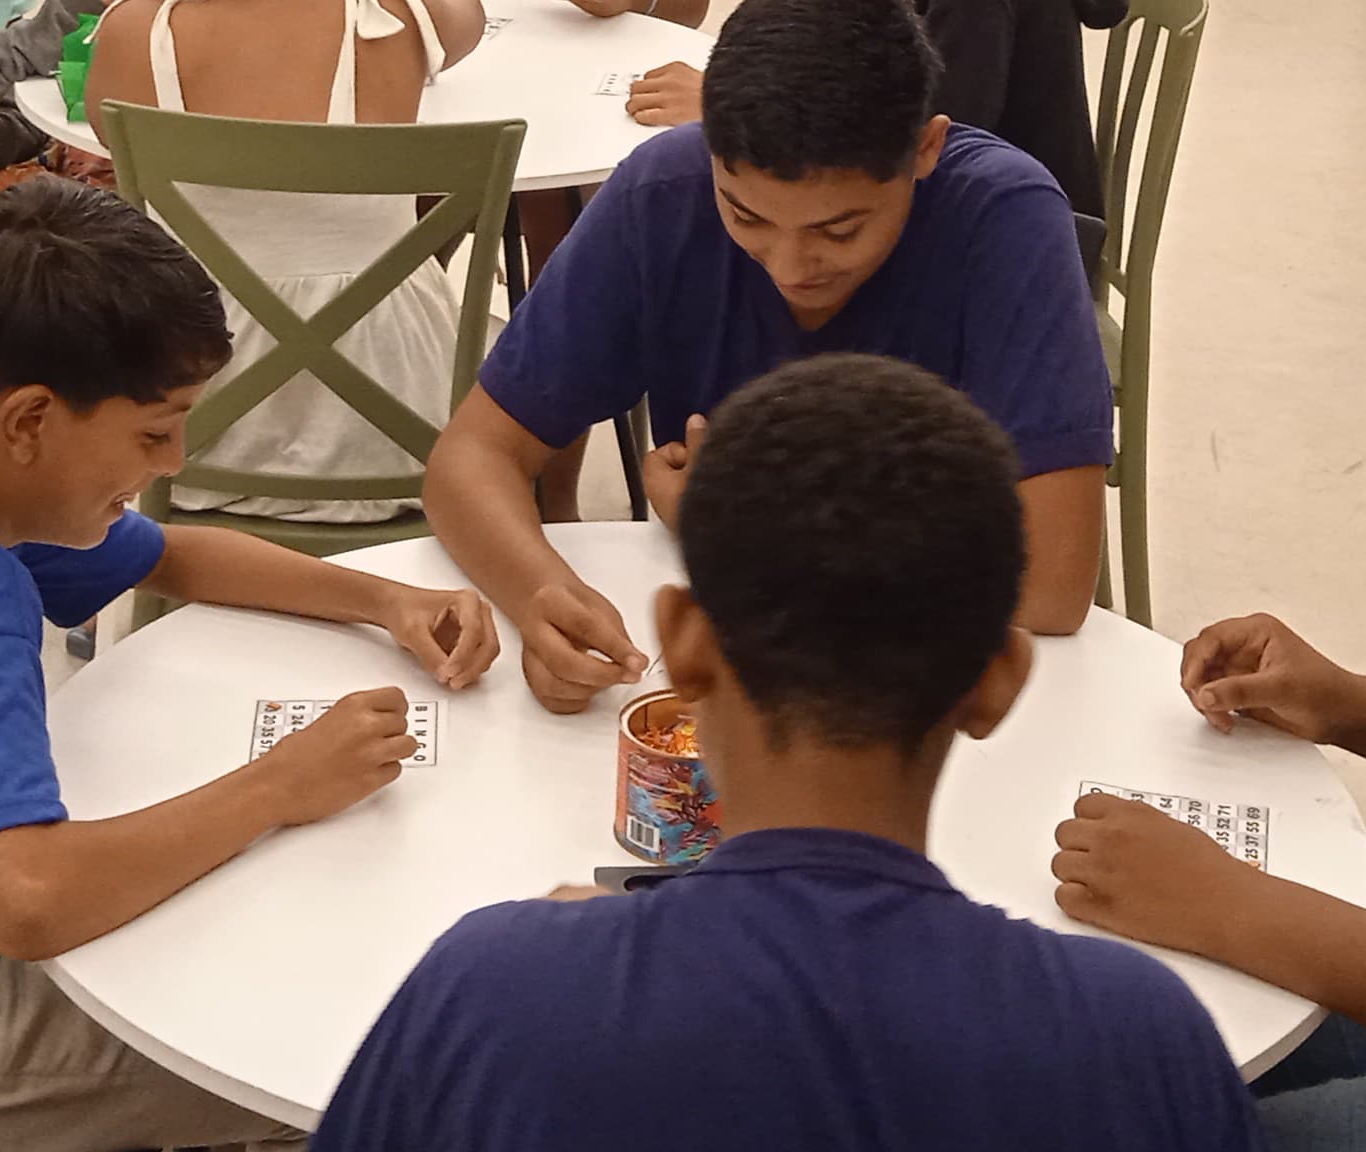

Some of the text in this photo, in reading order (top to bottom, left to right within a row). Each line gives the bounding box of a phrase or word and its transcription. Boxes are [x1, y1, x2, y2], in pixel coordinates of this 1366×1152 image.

[263, 715, 277, 726] 20
[291, 714, 304, 726] 24
[261, 727, 274, 738] 35
[1189, 801, 1203, 812] 70
[1247, 807, 1261, 819] 69
[1216, 805, 1231, 843] 35 52 71
[1246, 821, 1260, 833] 55
[1245, 835, 1260, 847] 37
